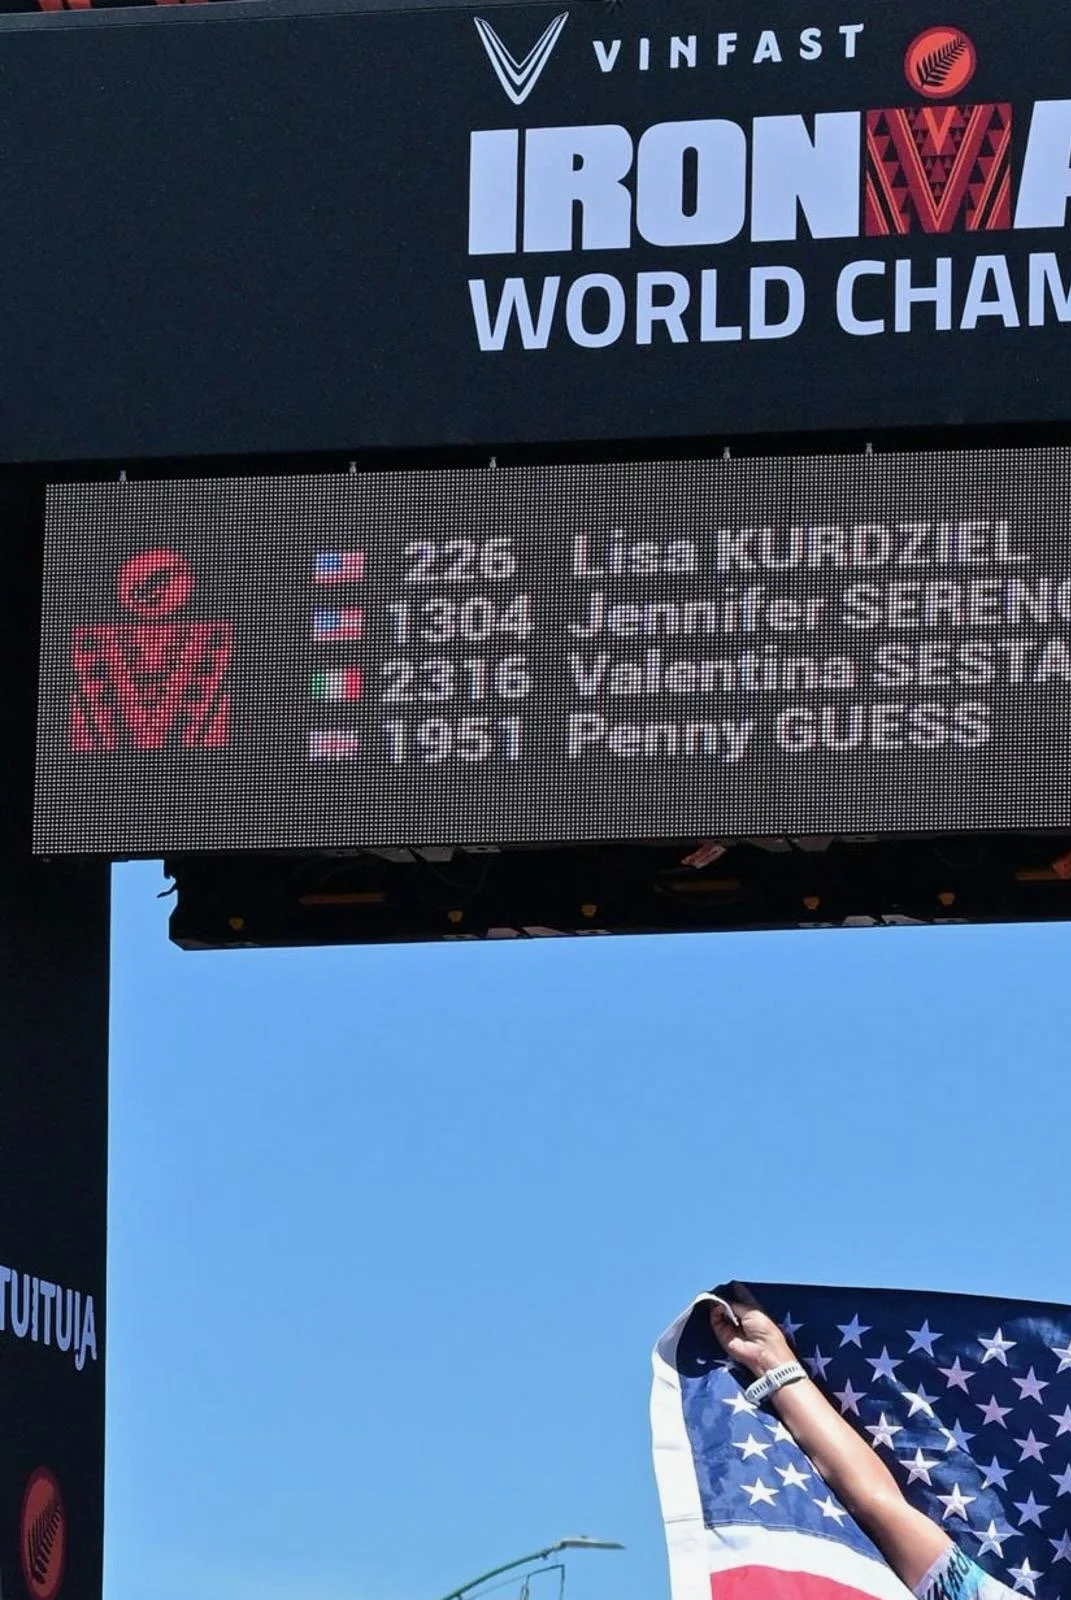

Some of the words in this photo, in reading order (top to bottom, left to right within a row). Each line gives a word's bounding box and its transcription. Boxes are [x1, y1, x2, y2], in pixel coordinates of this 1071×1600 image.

[593, 24, 864, 72] VINFAST
[468, 265, 804, 351] WORLD
[403, 537, 518, 582] 226
[573, 529, 695, 576] Lisa
[716, 520, 1031, 571] KURDZIEL
[384, 597, 535, 643] 1304
[567, 585, 823, 638] Jennifer
[380, 654, 533, 702] 2316
[567, 645, 857, 696] Valentina
[379, 715, 525, 764] 1951
[567, 711, 753, 763] Penny
[776, 702, 992, 753] GUESS
